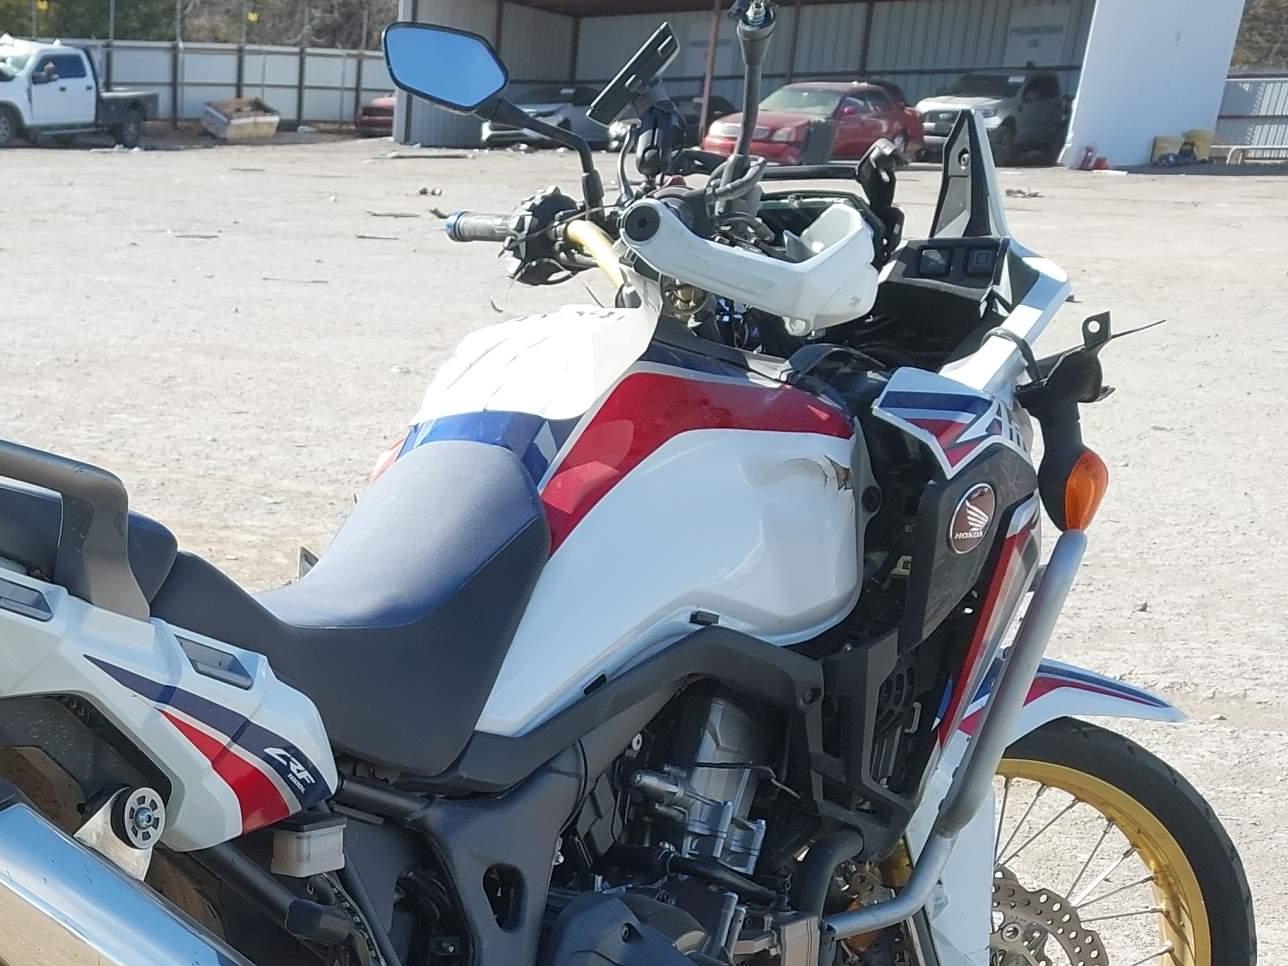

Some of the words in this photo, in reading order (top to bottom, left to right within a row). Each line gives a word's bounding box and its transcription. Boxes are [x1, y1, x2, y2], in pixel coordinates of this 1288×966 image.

[954, 530, 984, 539] HONDA
[263, 747, 315, 784] CRF
[287, 773, 306, 794] 1000L
